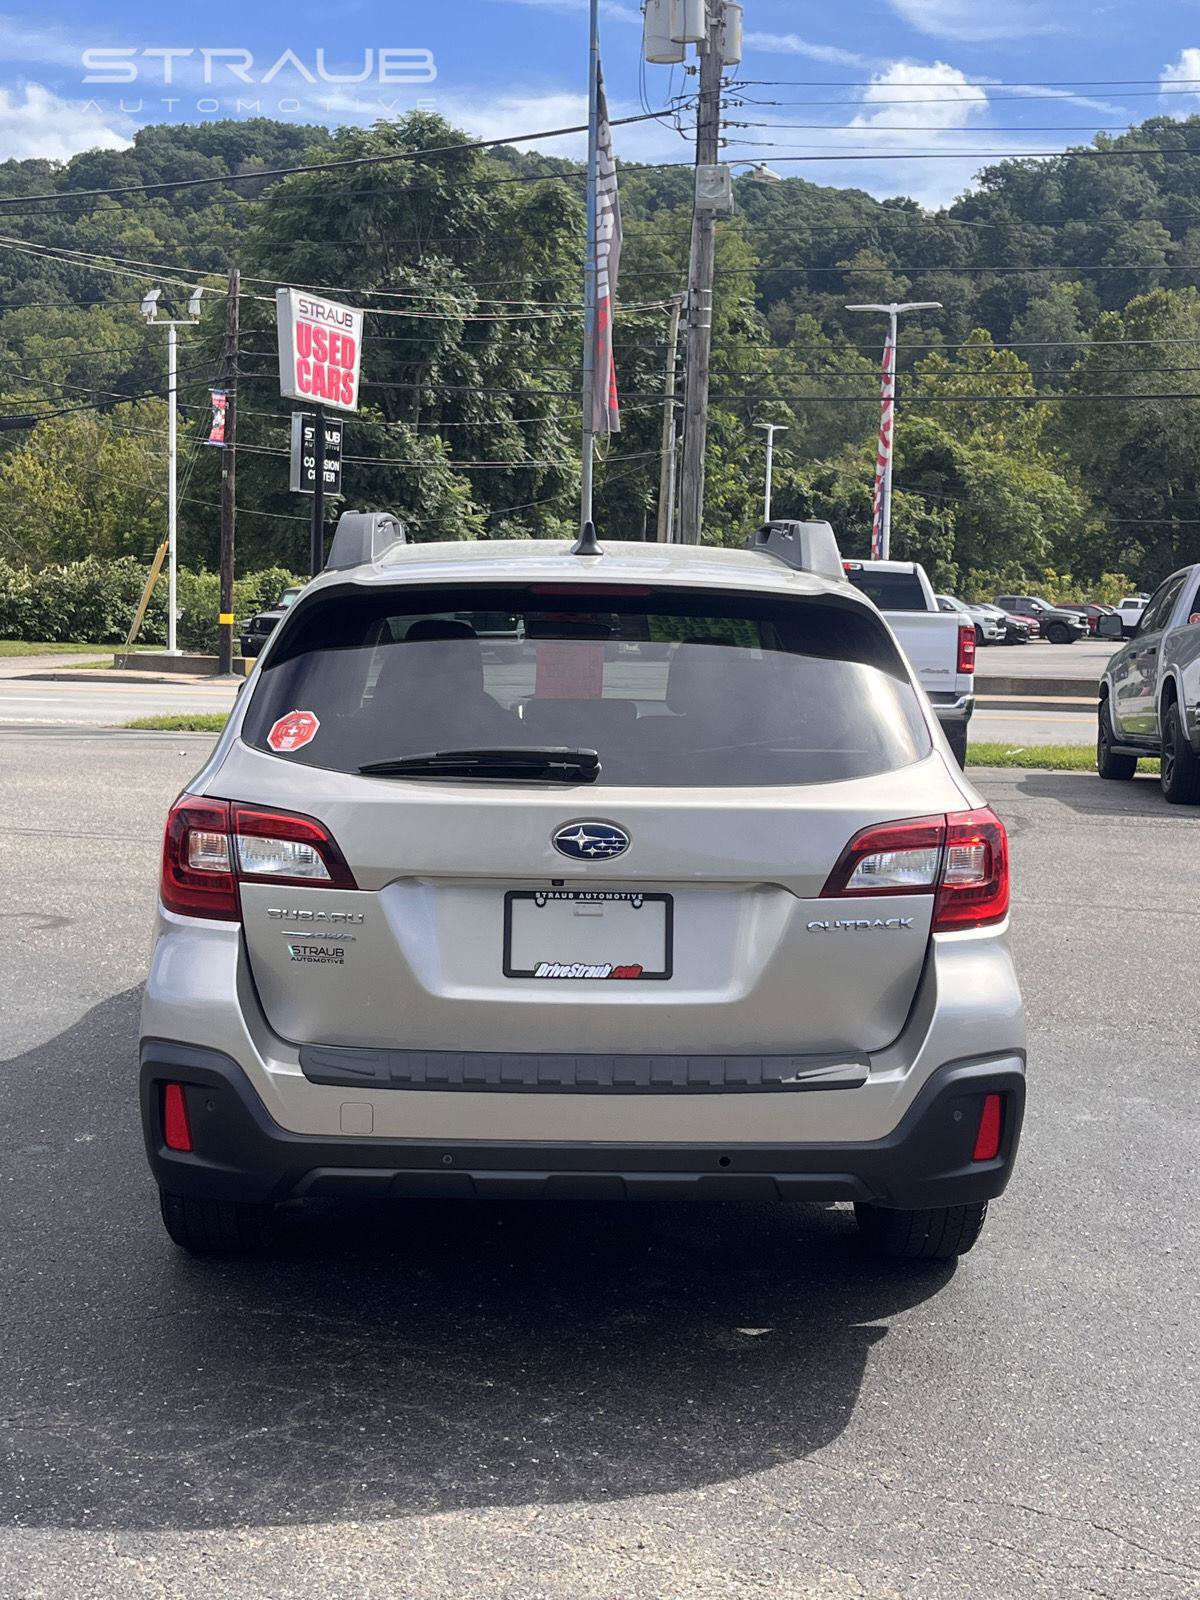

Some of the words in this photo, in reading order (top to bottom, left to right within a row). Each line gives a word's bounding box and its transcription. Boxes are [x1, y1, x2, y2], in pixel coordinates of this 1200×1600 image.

[299, 299, 353, 328] STRAUB
[296, 322, 355, 370] USED
[296, 357, 355, 405] CARS
[303, 456, 340, 471] COSION
[535, 892, 574, 900] STRAUB
[267, 907, 364, 925] SUBARU
[806, 917, 915, 932] OUTBACK
[290, 945, 345, 957] STRAUB
[290, 956, 345, 965] AUTOMOTIVE
